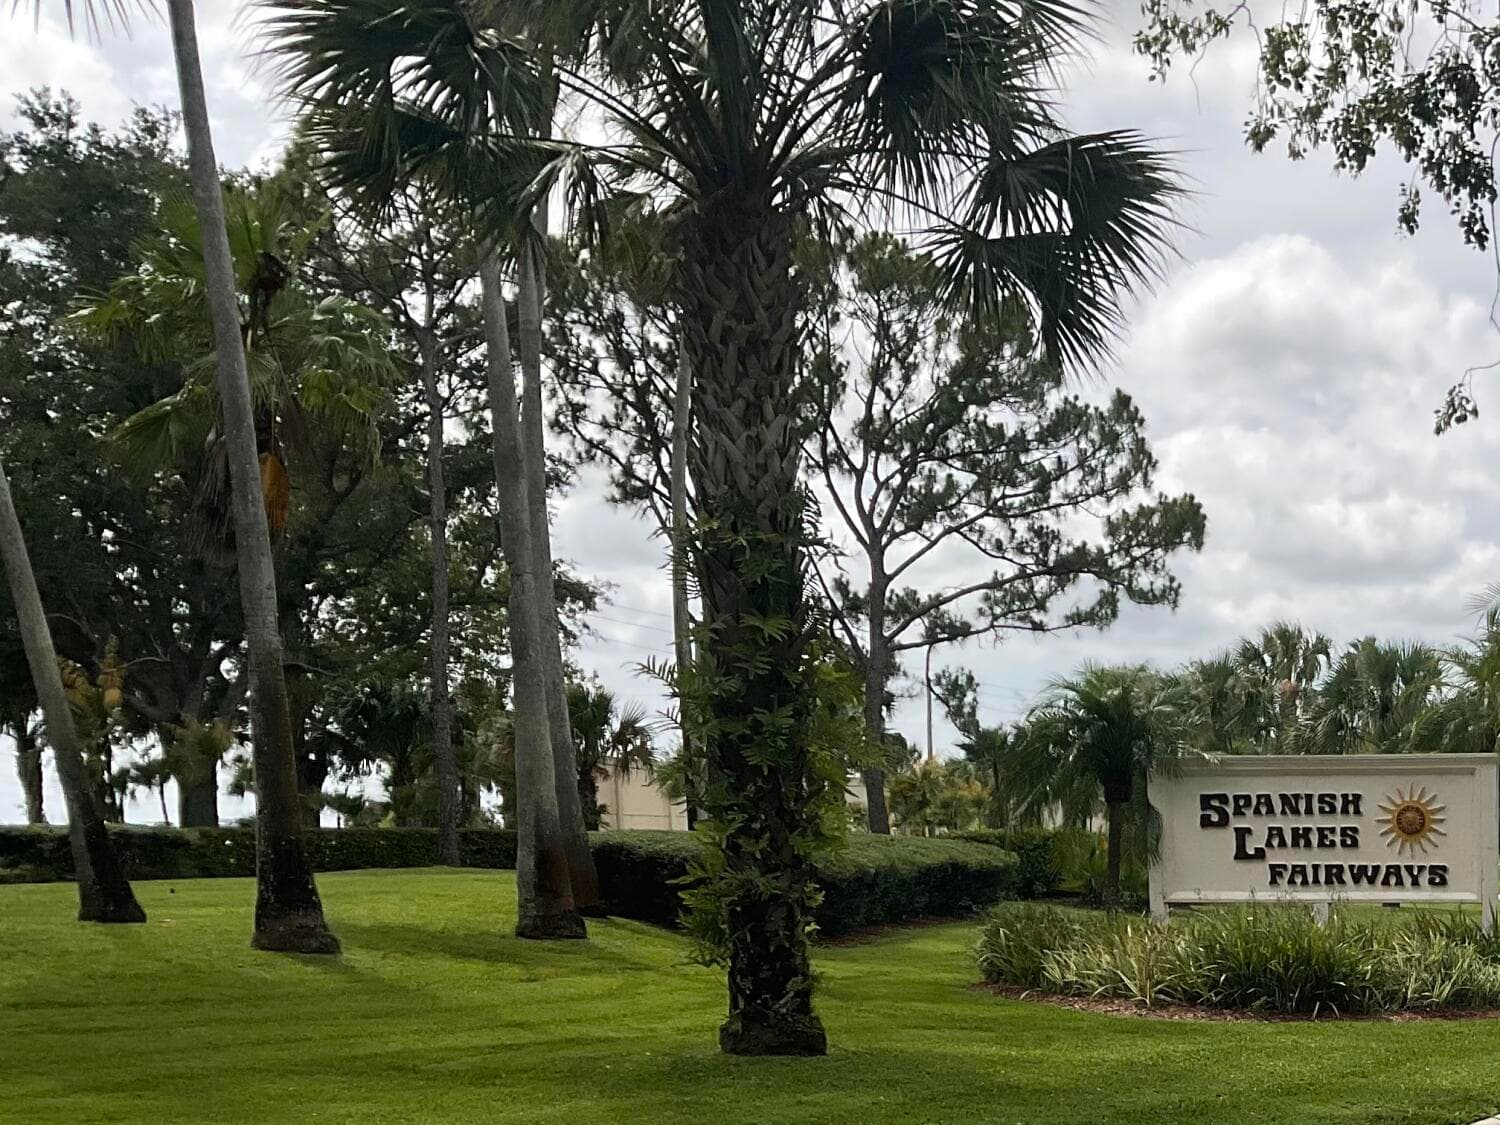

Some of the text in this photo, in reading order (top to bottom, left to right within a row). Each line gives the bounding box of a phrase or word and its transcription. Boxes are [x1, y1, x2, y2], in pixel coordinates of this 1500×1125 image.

[1199, 792, 1364, 829] SPANISH
[1232, 826, 1360, 862] LAKES
[1267, 863, 1449, 888] FAIRWAYS
